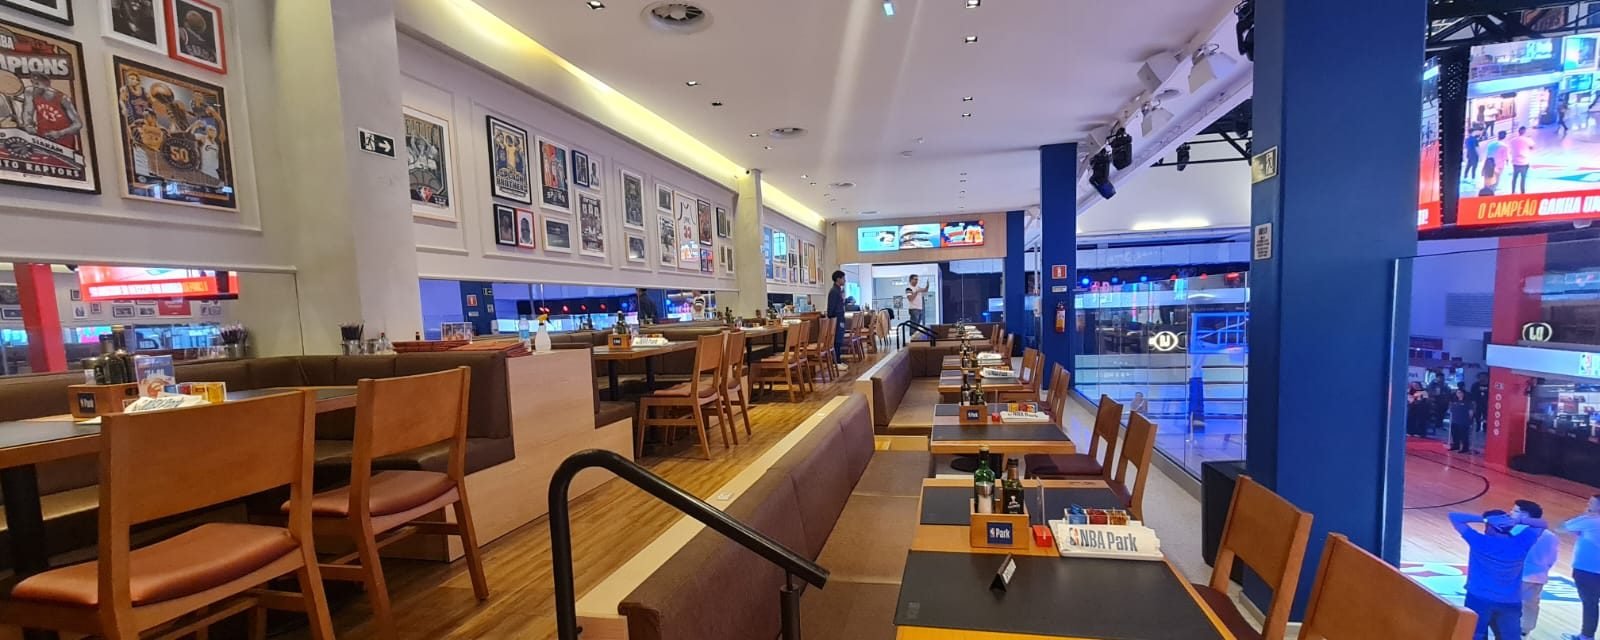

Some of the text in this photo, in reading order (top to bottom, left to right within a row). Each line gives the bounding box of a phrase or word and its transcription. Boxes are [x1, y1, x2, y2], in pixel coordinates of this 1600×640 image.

[0, 33, 15, 50] BA
[170, 146, 189, 163] 50
[0, 159, 80, 178] TO RAPTORS
[1477, 202, 1486, 220] O
[1487, 198, 1538, 219] CAMPEÃO
[1538, 196, 1582, 216] GANHA
[995, 527, 1010, 539] Park
[1080, 528, 1138, 552] NBA Park
